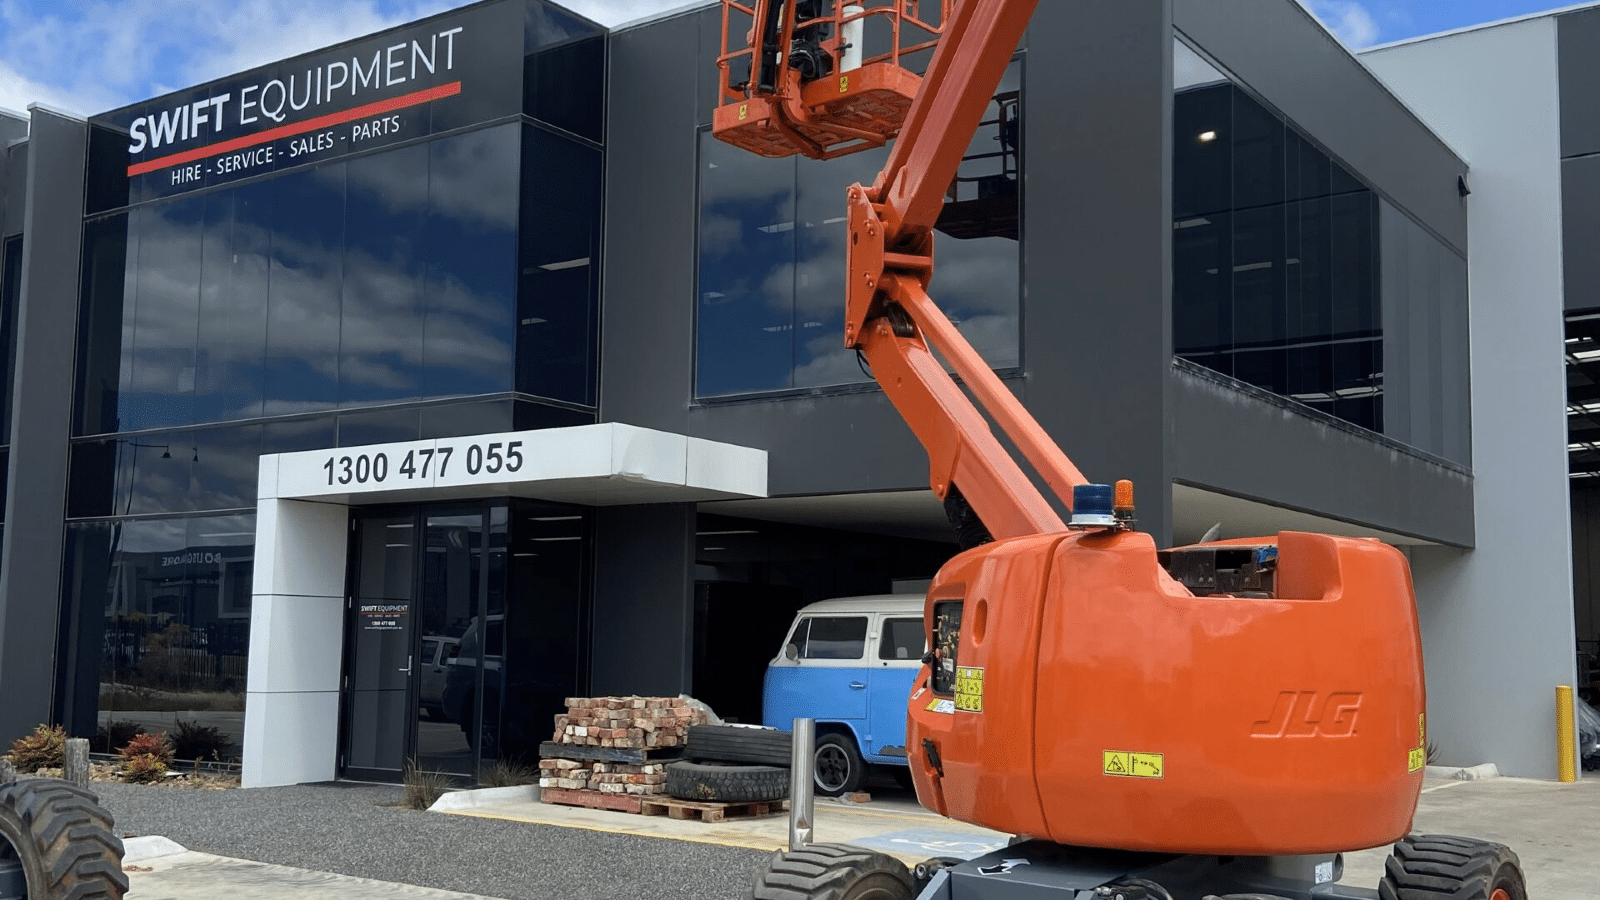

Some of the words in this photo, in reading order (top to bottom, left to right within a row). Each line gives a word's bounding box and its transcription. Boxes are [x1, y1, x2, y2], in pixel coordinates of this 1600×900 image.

[128, 93, 230, 154] SWIFT
[239, 27, 463, 125] EQUIPMENT
[171, 165, 202, 186] HIRE
[216, 147, 273, 175] SERVICE
[290, 131, 334, 157] SALES
[352, 115, 400, 142] PARTS
[323, 453, 388, 485] 1300
[399, 447, 453, 479] 477
[466, 441, 523, 475] 055
[1250, 690, 1363, 738] JLG
